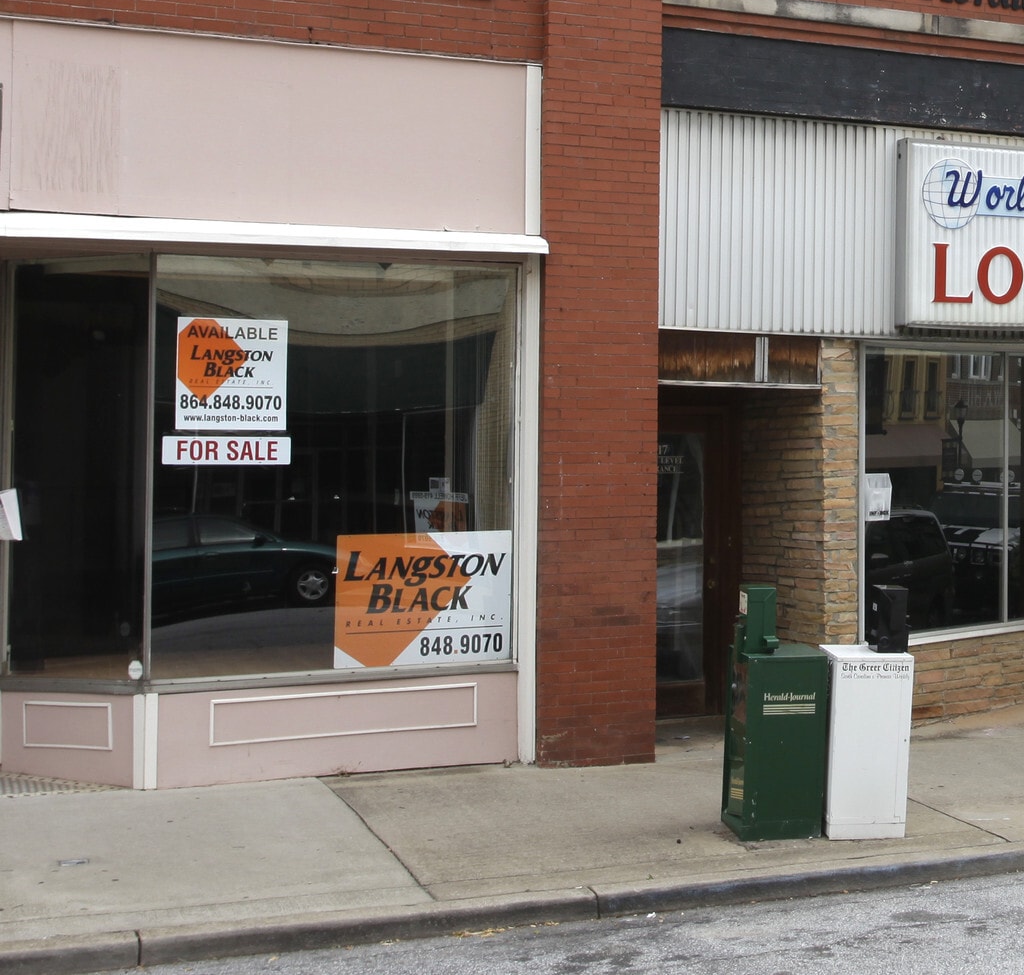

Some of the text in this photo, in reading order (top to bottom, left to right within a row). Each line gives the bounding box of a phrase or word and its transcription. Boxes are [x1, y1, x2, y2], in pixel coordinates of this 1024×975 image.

[187, 325, 278, 340] AVAILABLE
[203, 361, 256, 378] BLACK
[180, 394, 282, 410] 864.848.9070
[183, 414, 279, 423] www.langston-black.com
[176, 440, 278, 461] FOR SALE
[366, 583, 472, 615] BLACK
[345, 619, 384, 628] REAL
[470, 613, 504, 622] INC.
[420, 632, 503, 657] 848.9070
[842, 662, 910, 674] The Greer Citizen
[763, 692, 816, 701] Herald-Journal
